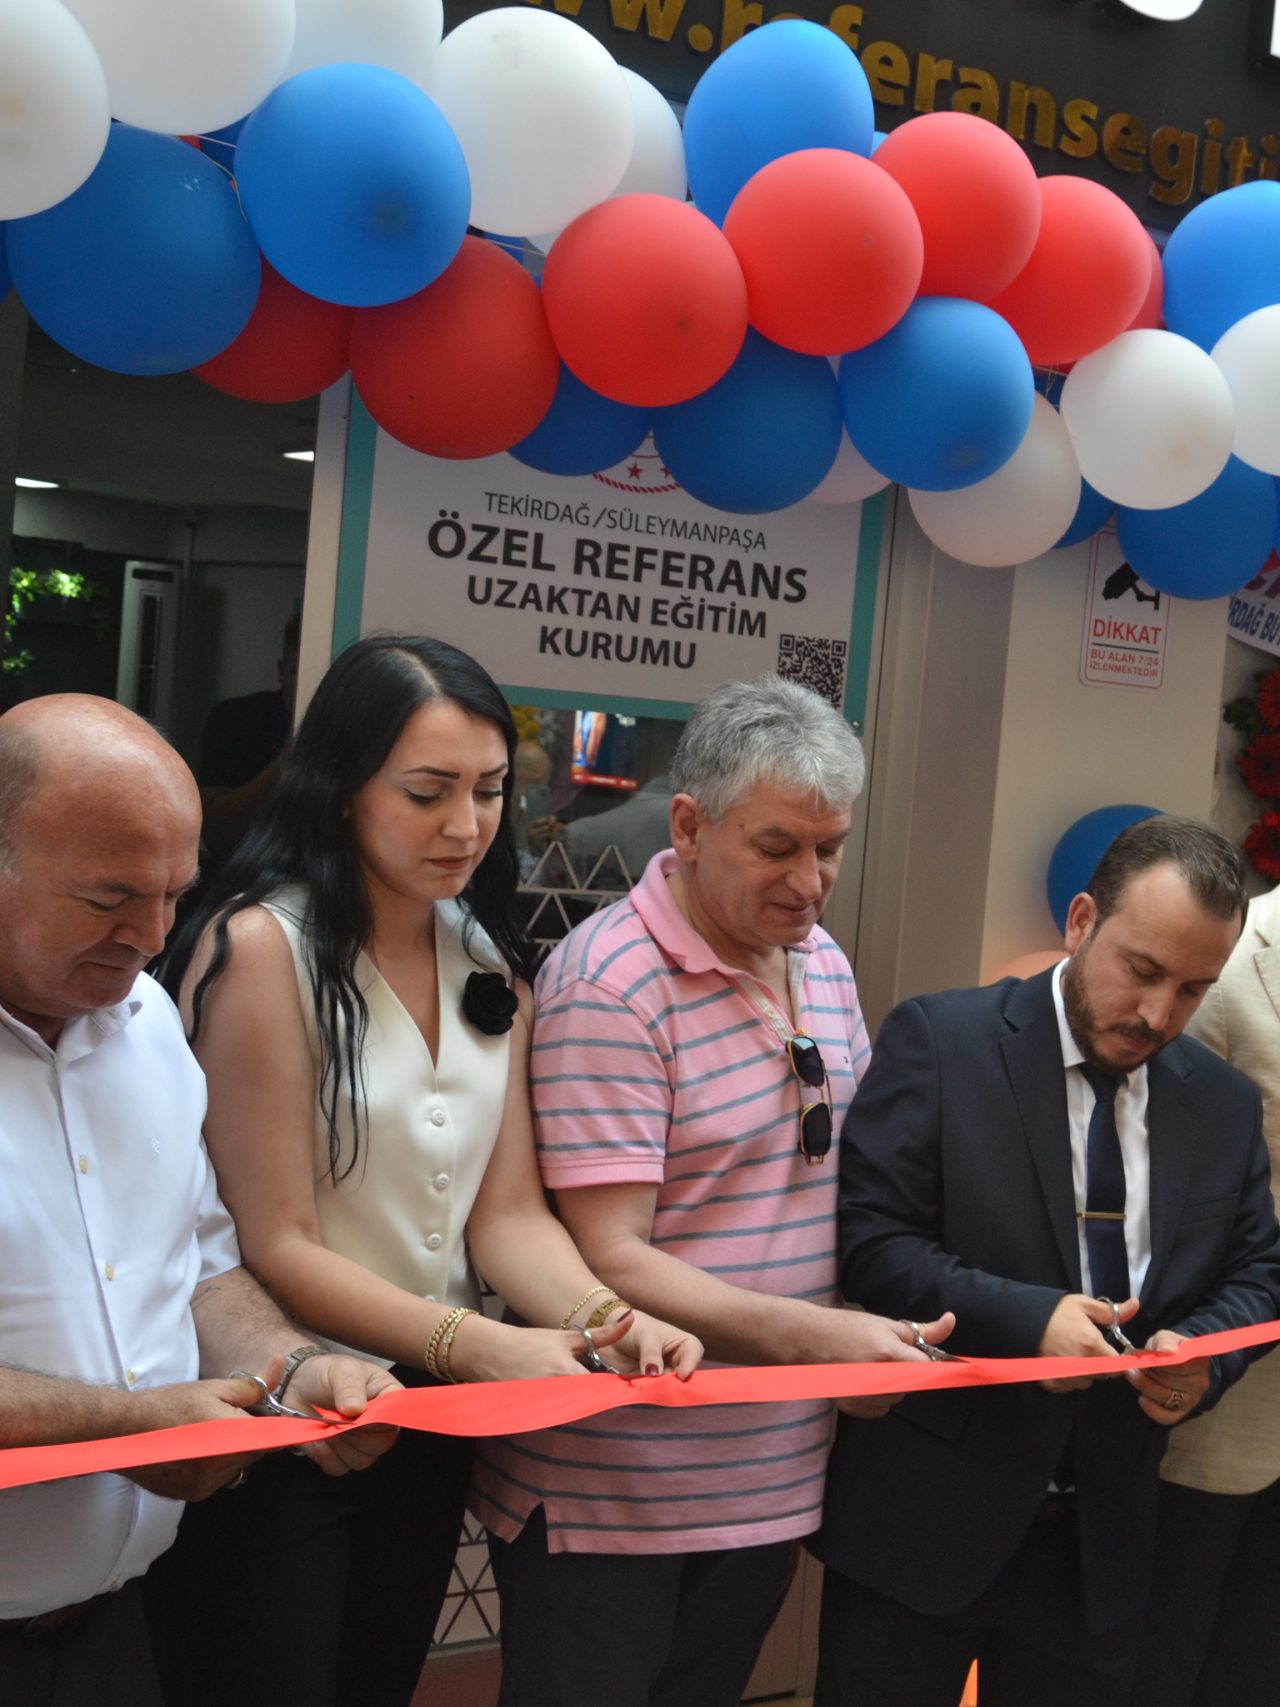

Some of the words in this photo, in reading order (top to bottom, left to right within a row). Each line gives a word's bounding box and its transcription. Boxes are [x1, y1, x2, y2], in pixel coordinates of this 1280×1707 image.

[427, 510, 556, 573] ÖZEL
[573, 538, 808, 603] REFERANS
[467, 575, 641, 623] UZAKTAN
[651, 595, 767, 638] EĞİTİM
[539, 626, 697, 669] KURUMU
[1093, 615, 1162, 645] DİKKAT
[1090, 648, 1105, 660] BU
[1108, 651, 1136, 665] ALAN
[1138, 654, 1159, 667] 7/24
